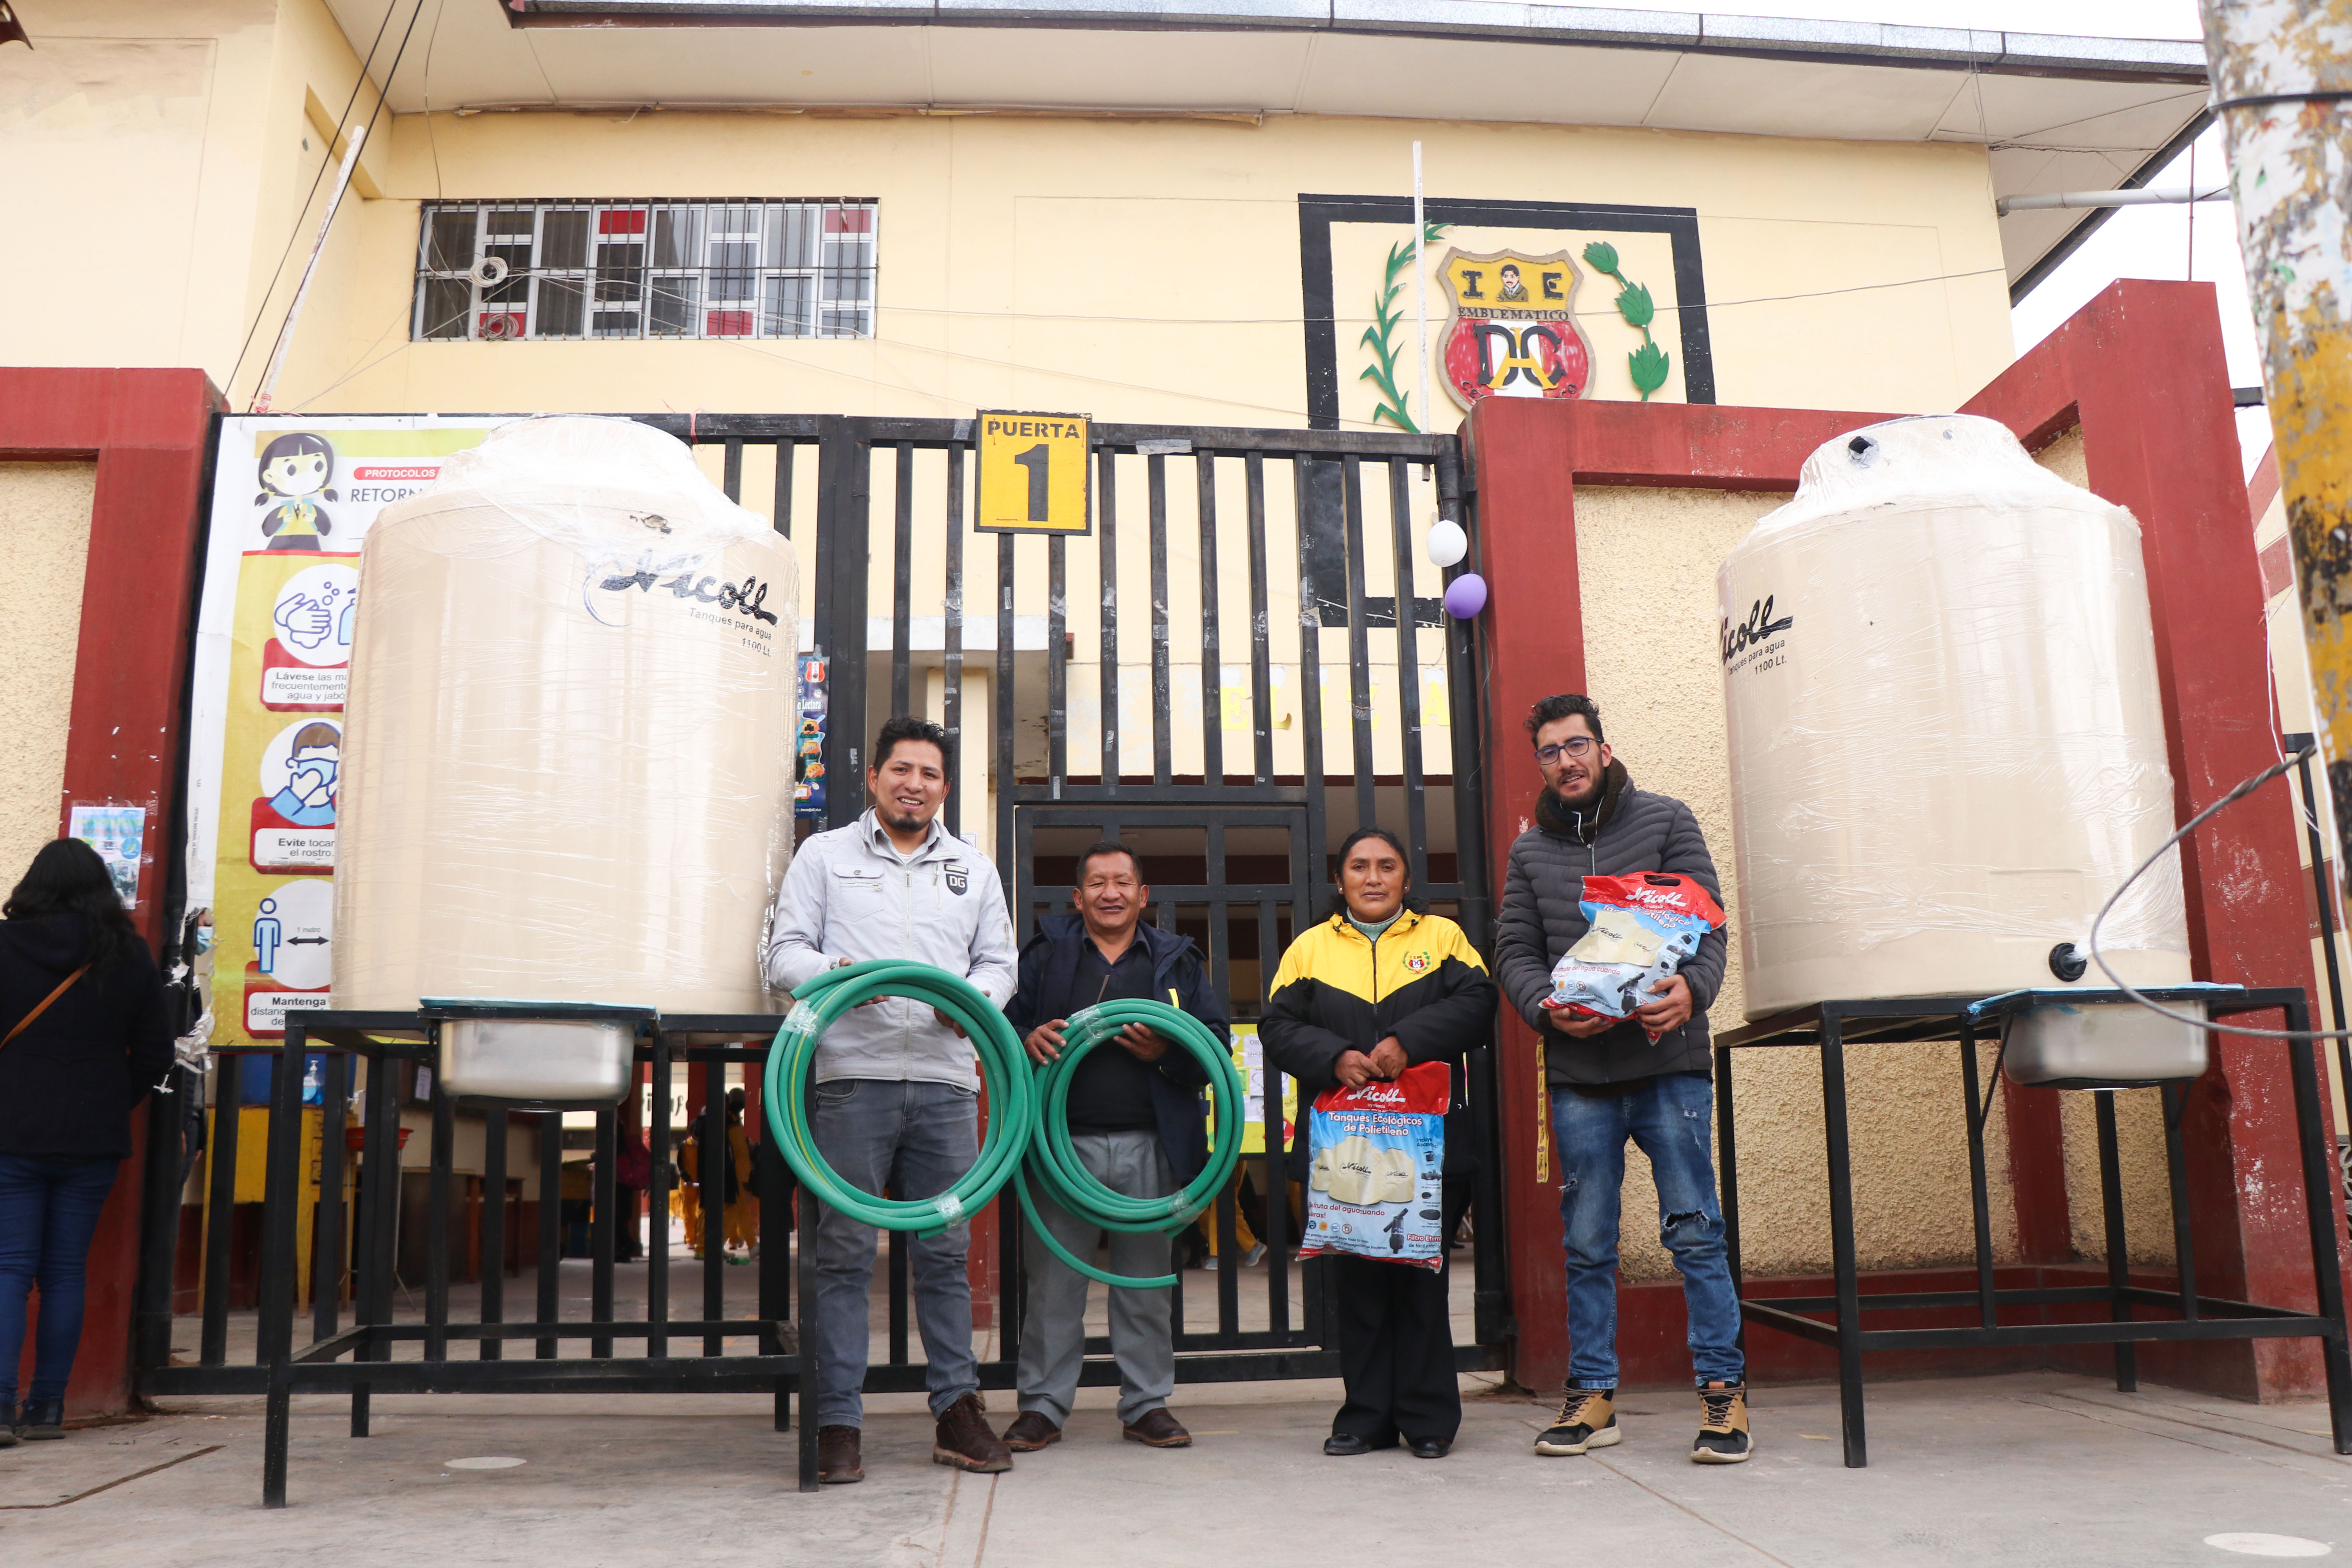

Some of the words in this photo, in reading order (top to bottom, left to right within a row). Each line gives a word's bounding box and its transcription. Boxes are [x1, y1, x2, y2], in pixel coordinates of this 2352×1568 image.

[1542, 272, 1565, 300] E
[1457, 307, 1568, 321] EMBLEMATICO
[987, 421, 1080, 439] PUERTA
[365, 469, 436, 477] PROTOCOLOS
[1014, 443, 1049, 521] 1
[690, 607, 732, 626] Tanques
[735, 621, 753, 633] para
[756, 628, 772, 640] agua
[1719, 594, 1794, 666] icoll
[742, 638, 762, 653] 1100
[1728, 657, 1747, 677] Tanques
[1748, 649, 1762, 664] para
[1765, 640, 1785, 654] agua
[1755, 659, 1773, 675] 1100
[1776, 655, 1787, 666] Lt.
[276, 672, 314, 681] Lávese
[287, 692, 312, 701] agua
[802, 699, 822, 710] Lectora
[278, 838, 306, 846] Evite
[1625, 887, 1687, 907] Nicoll
[272, 997, 326, 1007] Mantenga
[1346, 1085, 1406, 1102] Nicoll
[1329, 1112, 1370, 1123] Tanques
[1372, 1113, 1423, 1127] Ecológicos
[1343, 1123, 1357, 1132] de
[1359, 1123, 1409, 1136] Polietileno
[1342, 1206, 1360, 1214] agua
